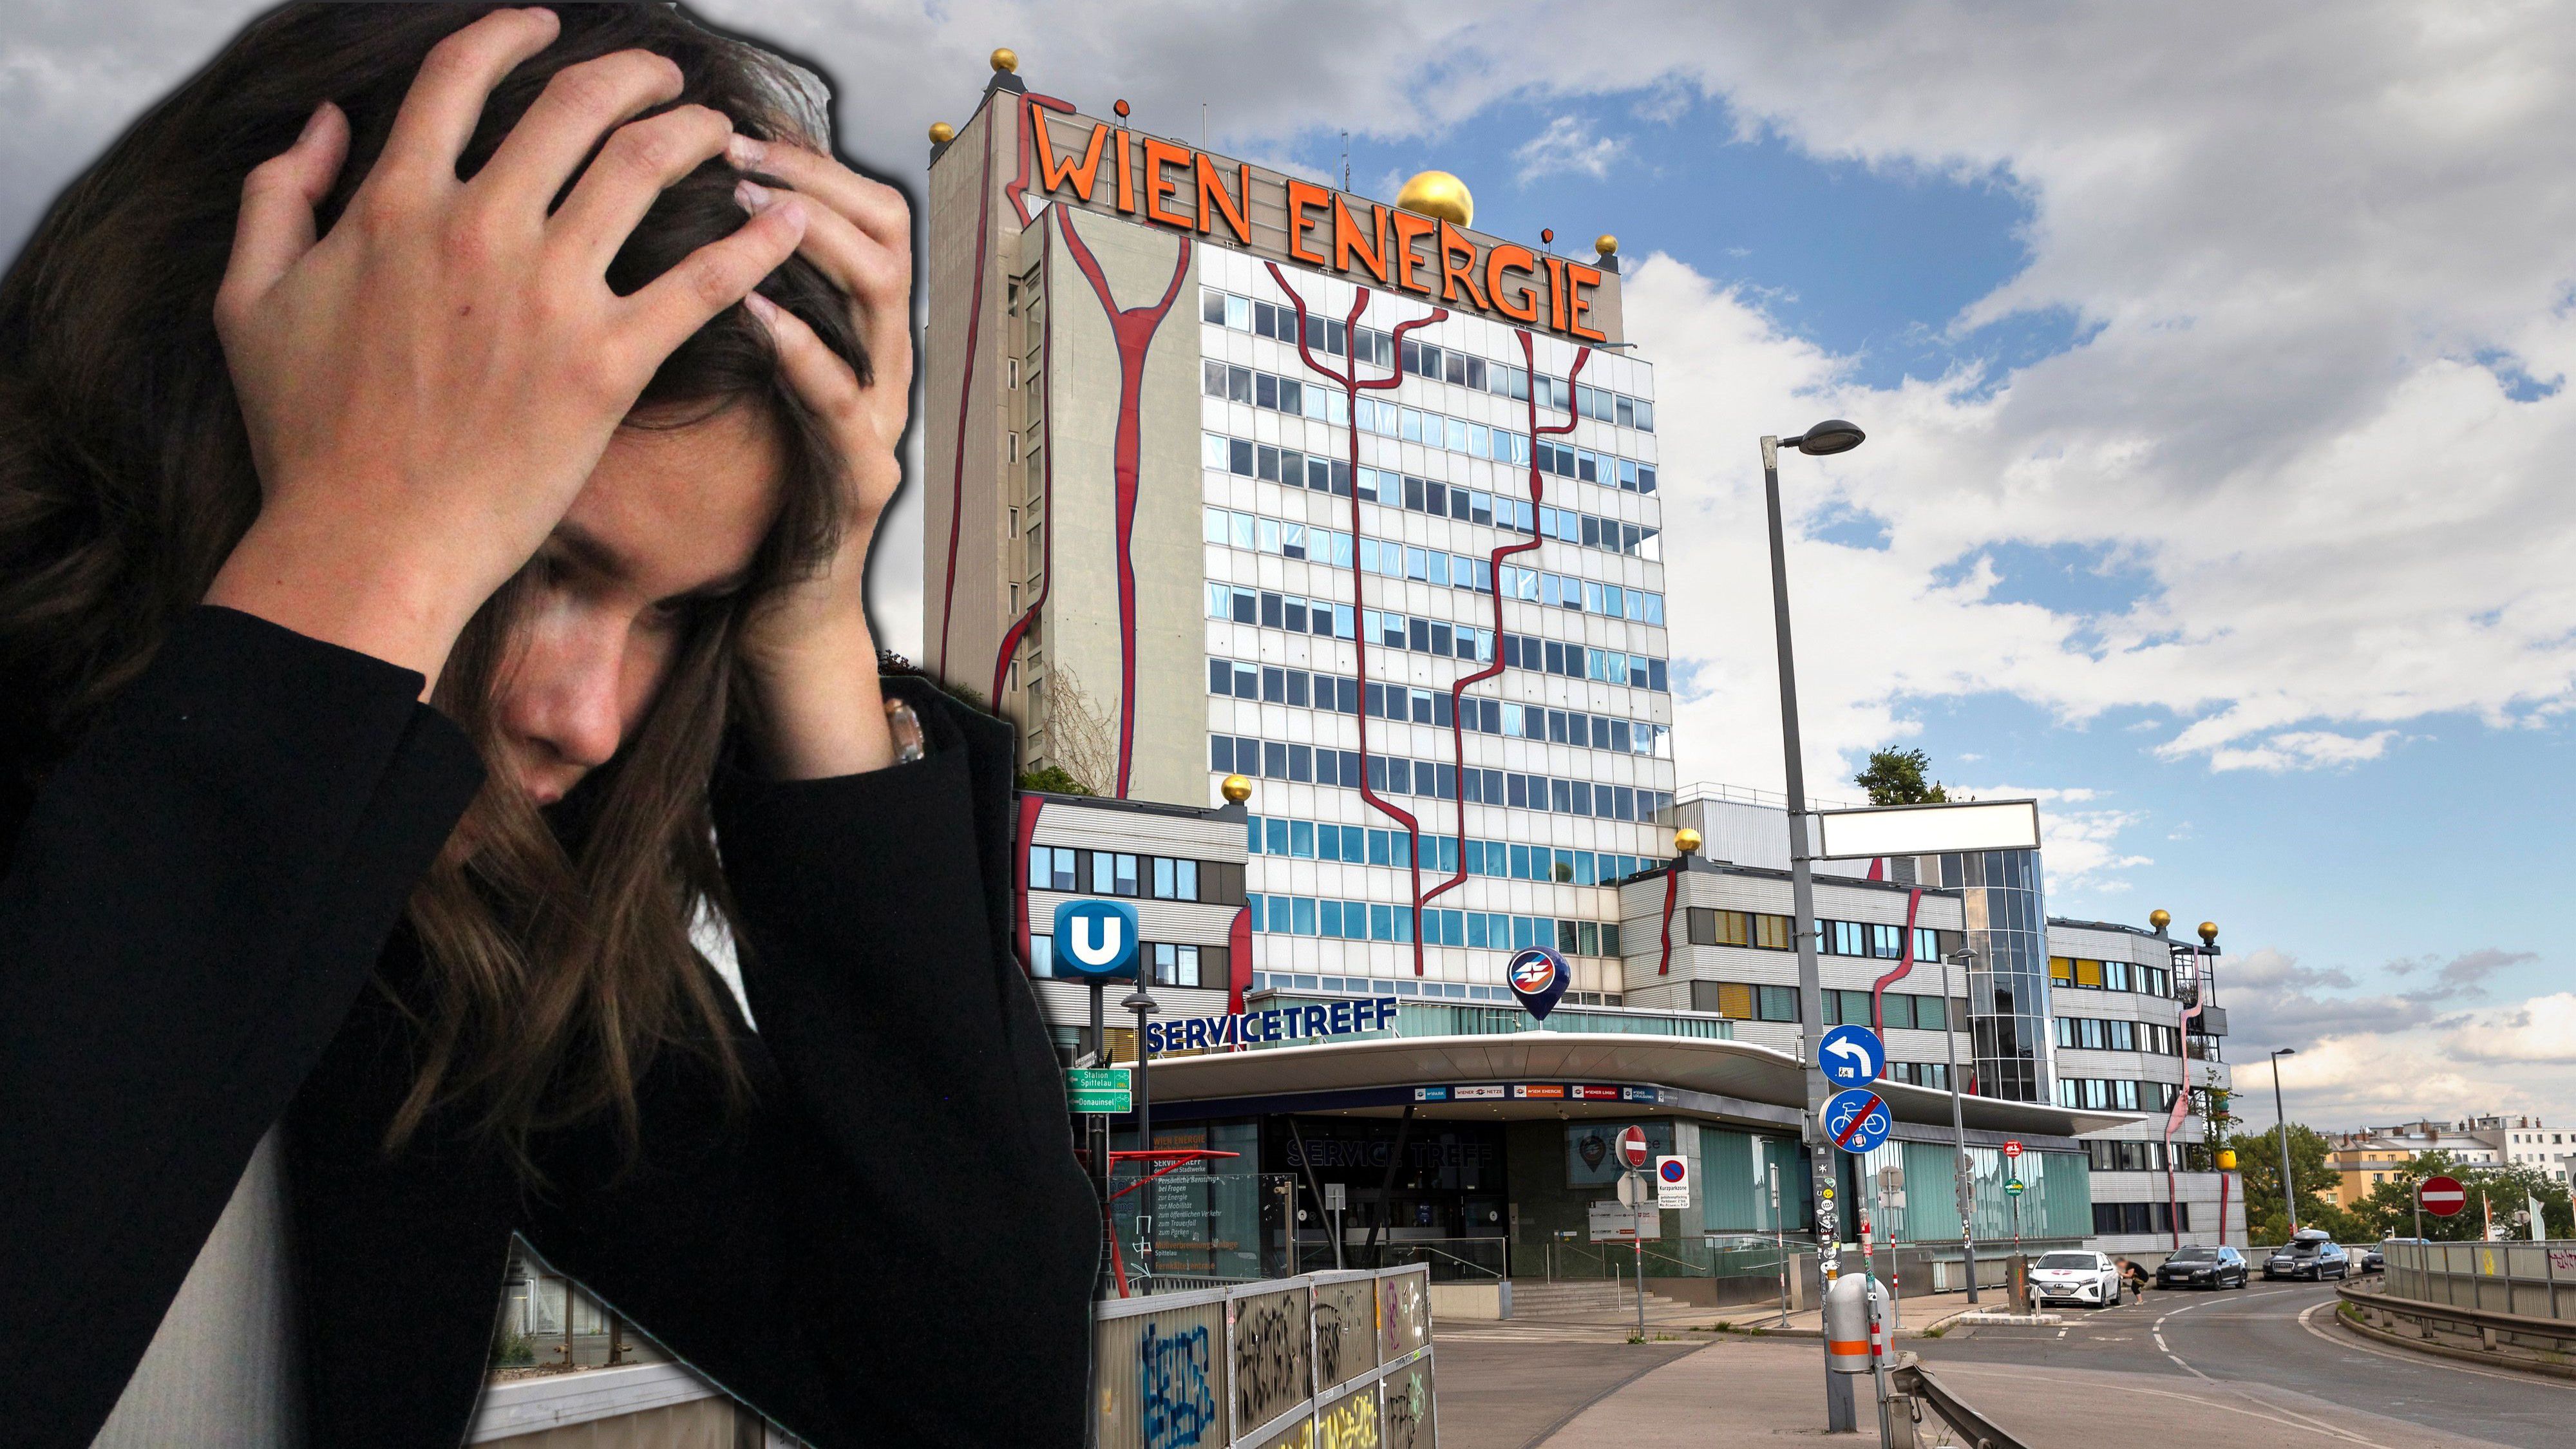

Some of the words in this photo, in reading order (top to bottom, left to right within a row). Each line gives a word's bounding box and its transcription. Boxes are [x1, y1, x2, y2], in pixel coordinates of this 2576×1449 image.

[1030, 100, 1251, 245] WIEN
[1286, 178, 1607, 343] ENERGIE
[1071, 916, 1121, 965] U
[1146, 998, 1399, 1053] SERVICETREFF
[1081, 1079, 1112, 1087] Spittelau
[1153, 1136, 1173, 1145] WIEN
[1175, 1135, 1206, 1144] ENERGIE
[1410, 1143, 1492, 1168] TREFF
[1168, 1193, 1188, 1202] Energie
[1171, 1219, 1196, 1227] Trauerfall
